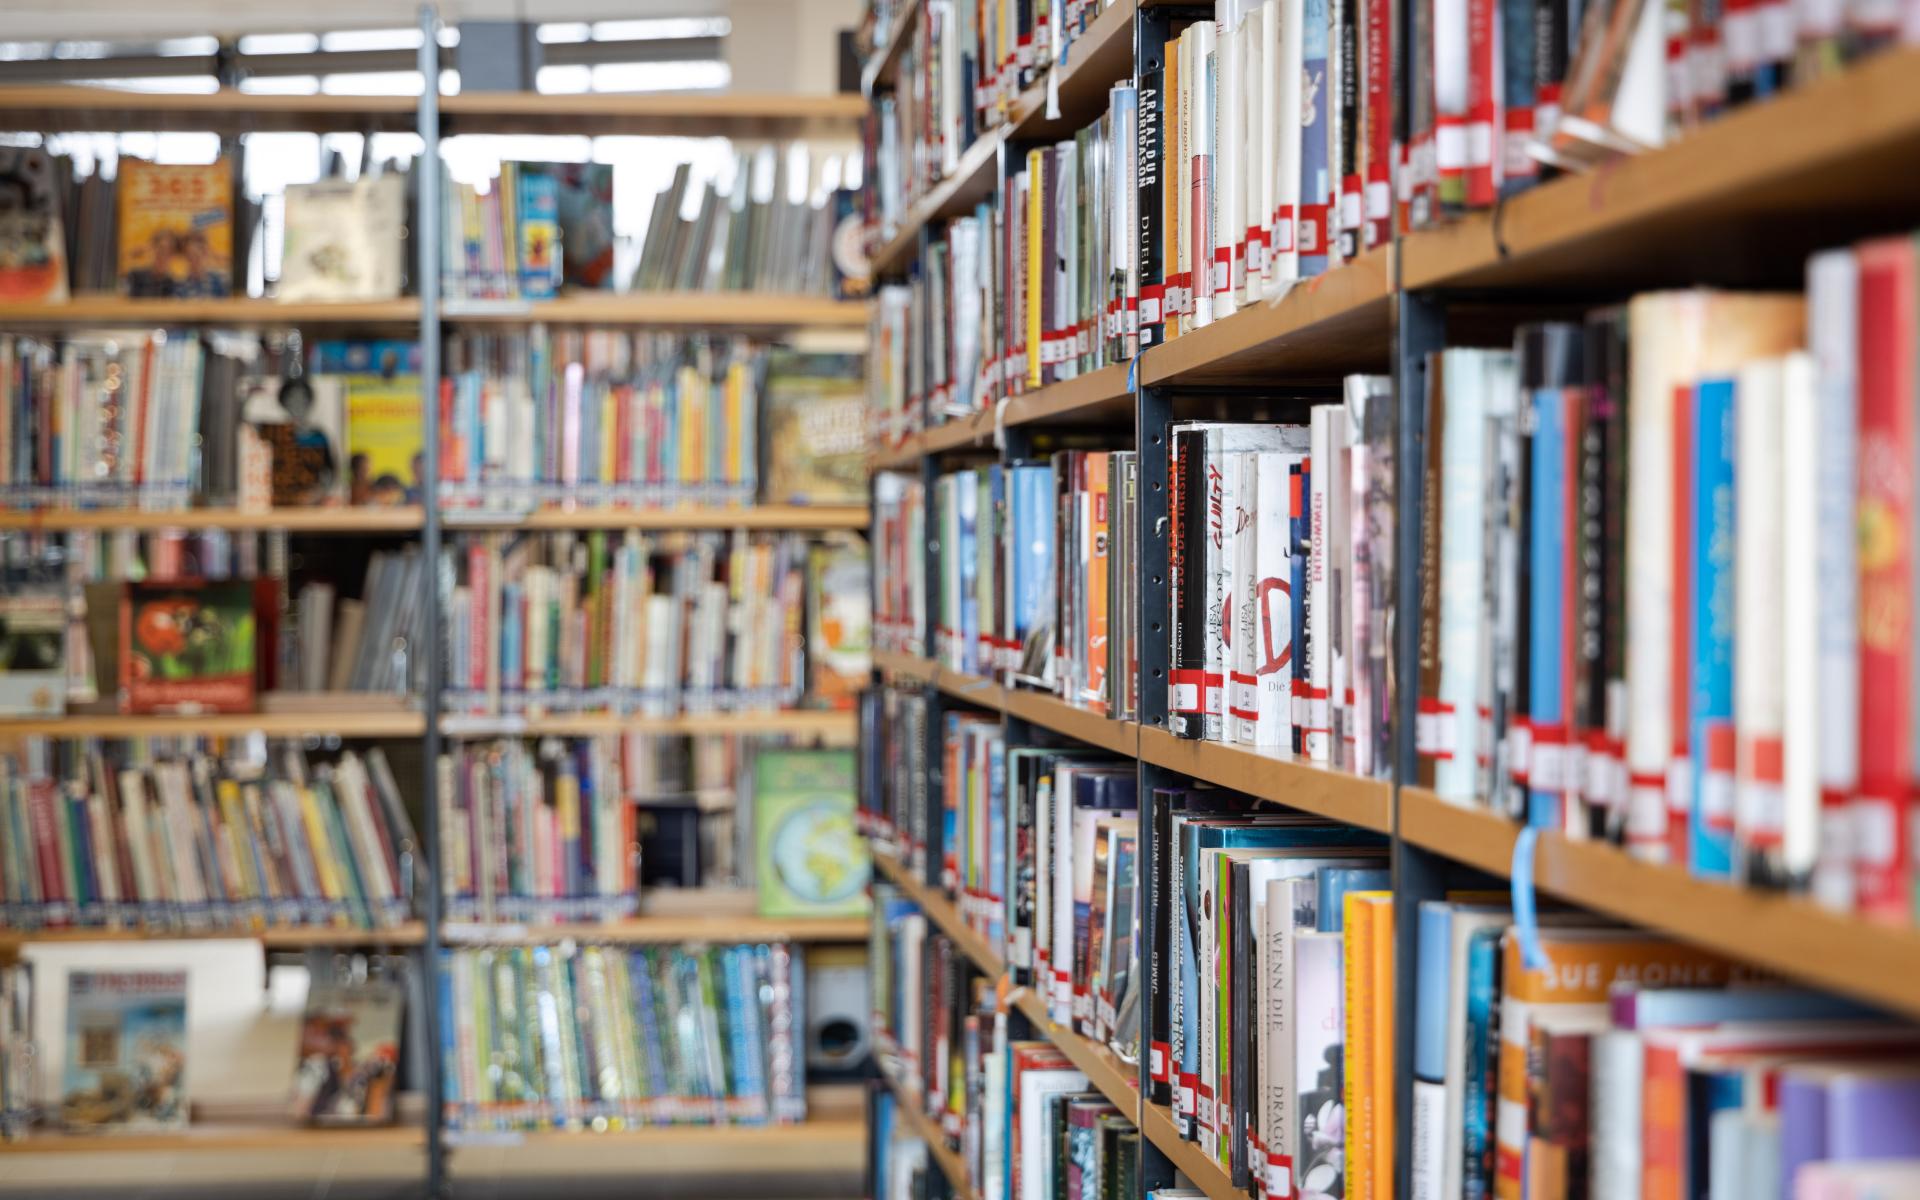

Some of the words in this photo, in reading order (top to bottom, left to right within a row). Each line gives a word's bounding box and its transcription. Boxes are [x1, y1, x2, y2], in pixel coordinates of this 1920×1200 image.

[1145, 88, 1157, 187] ARNALDUR
[1178, 444, 1187, 517] IRRSINNS
[1208, 464, 1223, 551] GUILTY
[1312, 491, 1322, 582] ENTKOMMEN
[1177, 590, 1184, 608] IM
[1247, 574, 1255, 662] JACKSON
[1303, 556, 1312, 637] Jackson
[1268, 681, 1285, 692] Die
[1303, 642, 1312, 686] Lisa
[1272, 931, 1284, 989] WENN
[1542, 961, 1601, 992] SUE
[1615, 961, 1714, 988] MONK
[1272, 998, 1284, 1032] DIE
